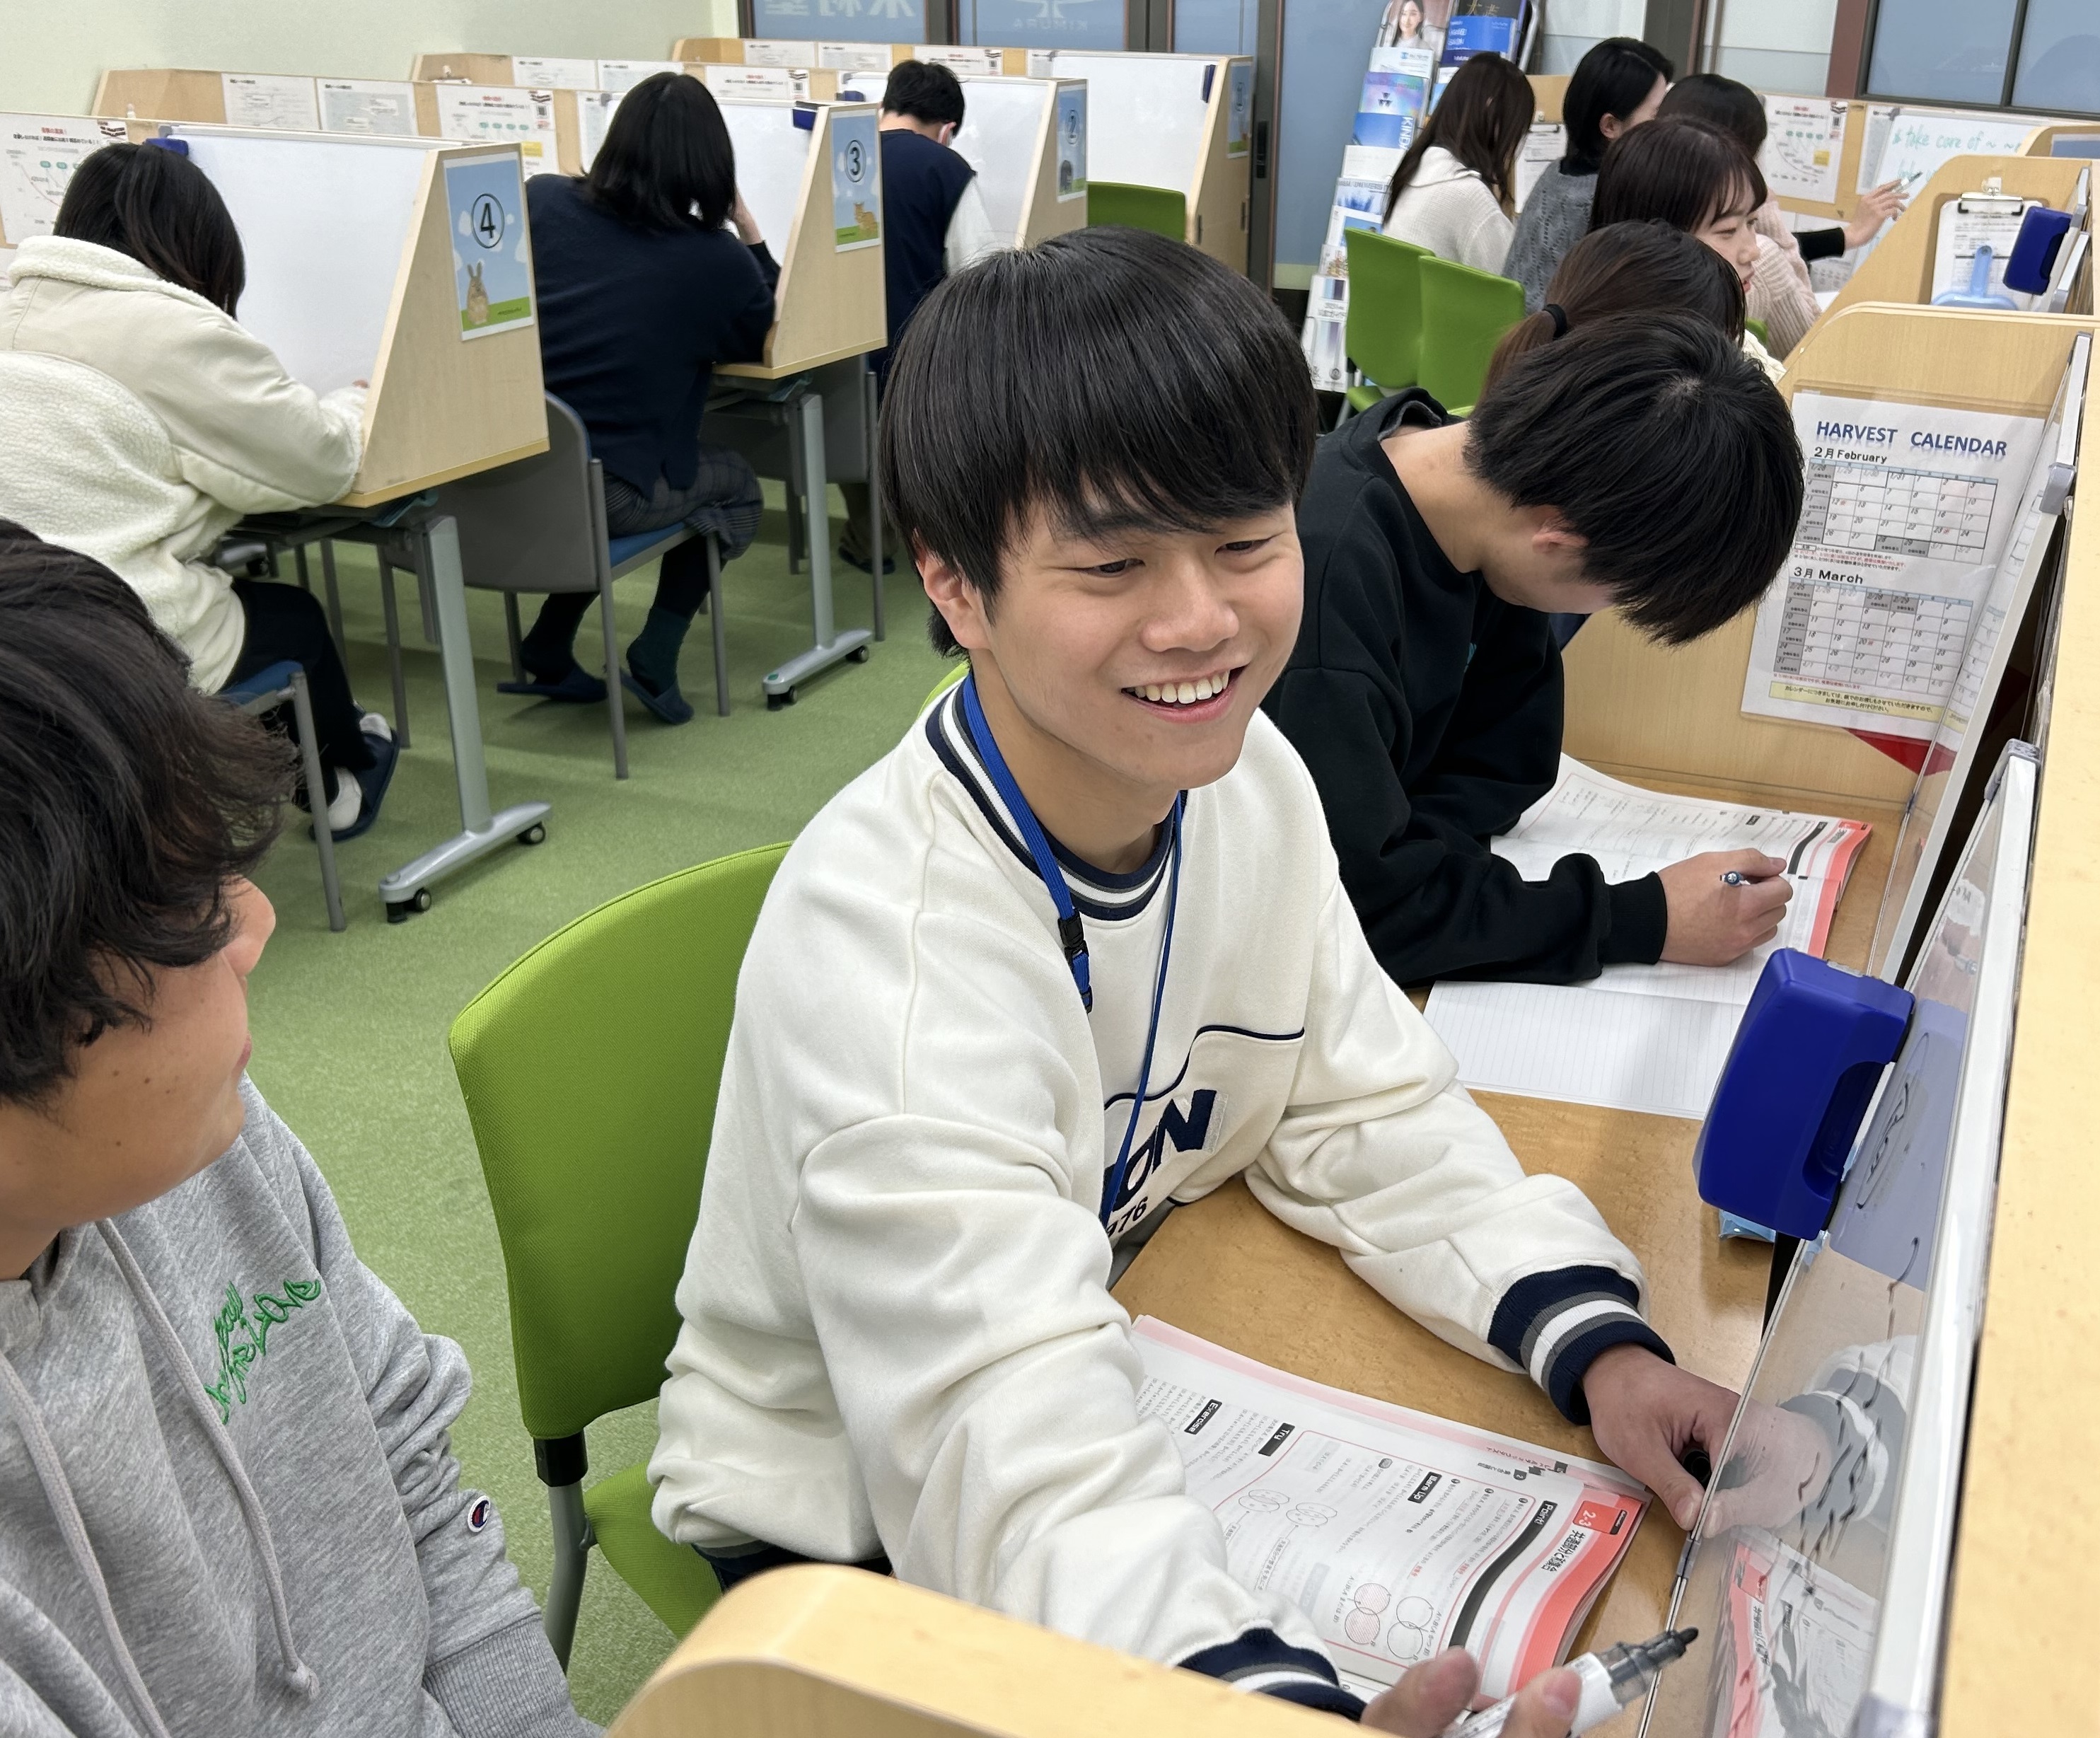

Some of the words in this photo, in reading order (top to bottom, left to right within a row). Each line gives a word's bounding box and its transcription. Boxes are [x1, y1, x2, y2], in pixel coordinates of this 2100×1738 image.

[1967, 129, 1984, 151] of
[1816, 421, 1898, 444] HARVEST
[1911, 431, 2007, 456] CALENDAR
[1814, 446, 1833, 459] 2月
[1838, 449, 1887, 464] February
[1794, 567, 1813, 579] 3月
[1818, 569, 1864, 584] March
[1189, 1403, 1219, 1433] Exercise
[1274, 1428, 1290, 1441] Try
[1421, 1475, 1438, 1491] Warm
